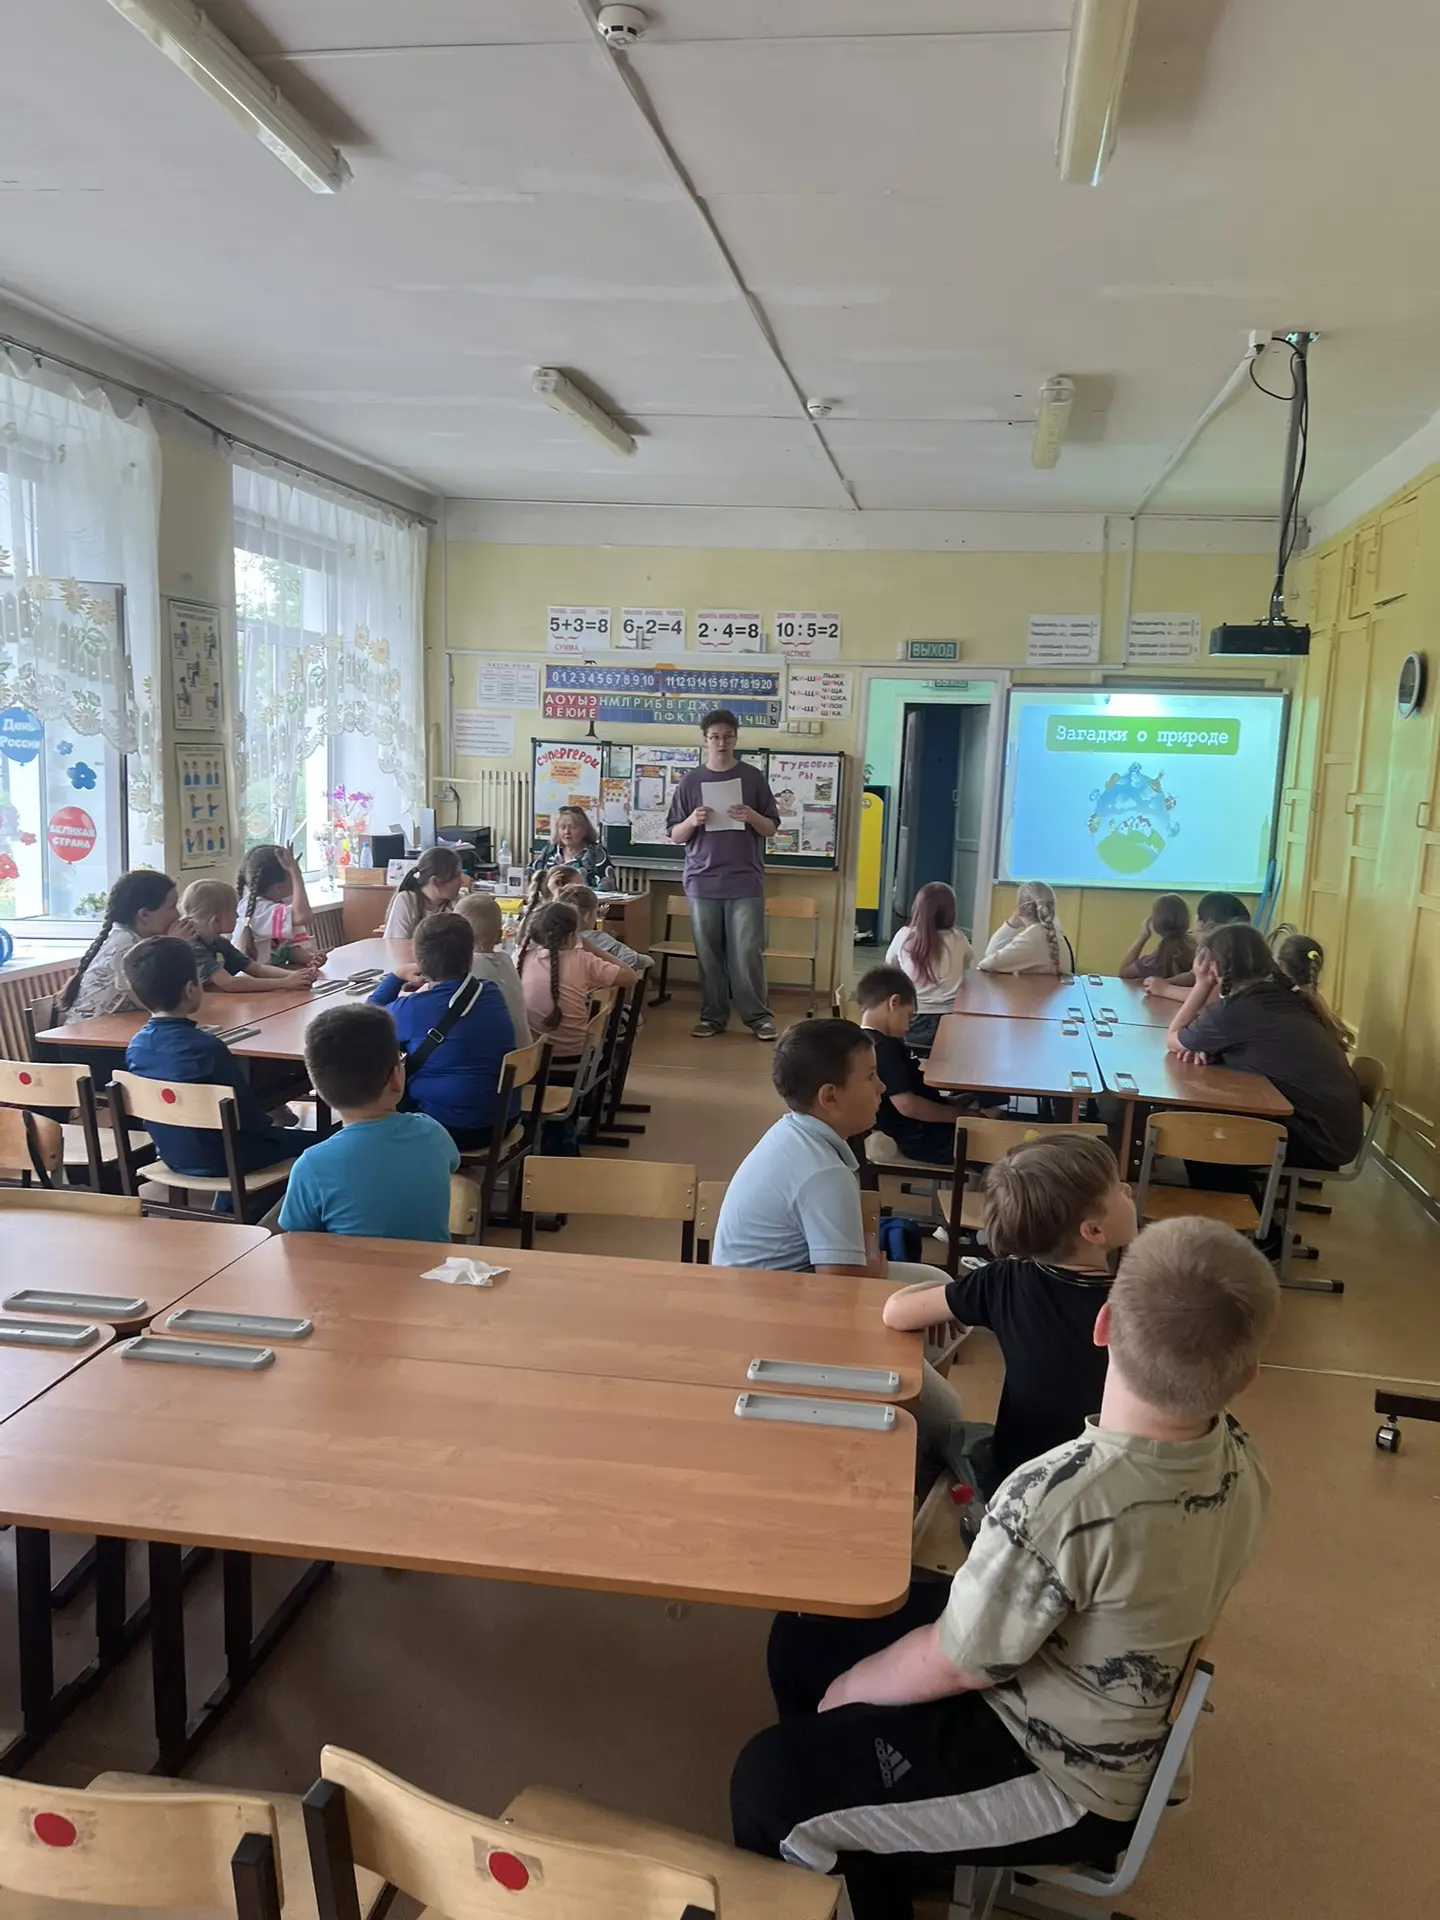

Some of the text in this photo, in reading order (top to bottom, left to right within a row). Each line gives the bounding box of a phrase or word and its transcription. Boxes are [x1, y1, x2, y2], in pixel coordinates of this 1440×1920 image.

[550, 618, 608, 633] 5+3=8
[622, 619, 682, 634] 6-2=4
[912, 644, 954, 657] ВЫХОД
[2, 718, 36, 732] День
[1056, 724, 1228, 747] Загадки о природе
[52, 836, 90, 848] СТРАНА
[874, 1737, 893, 1788] adidas
